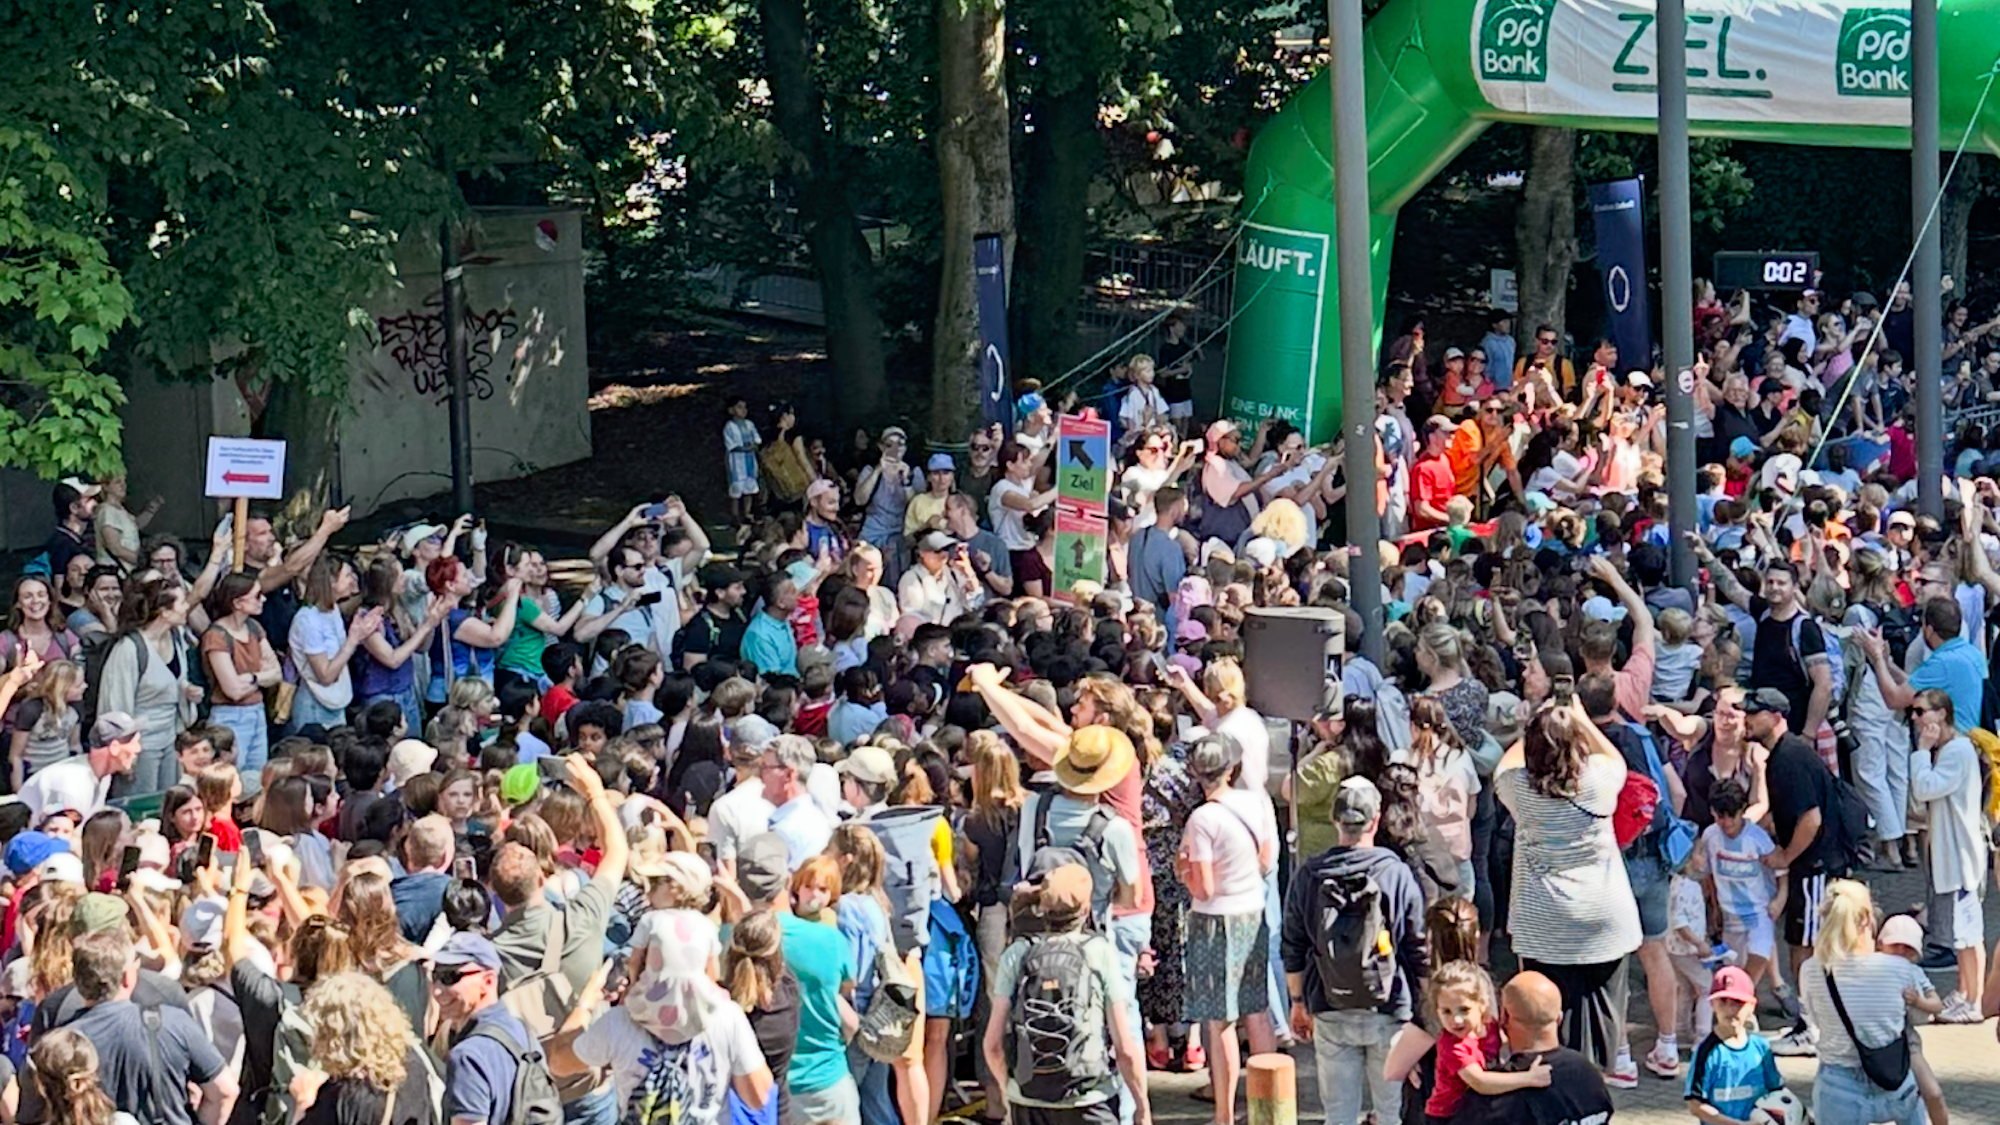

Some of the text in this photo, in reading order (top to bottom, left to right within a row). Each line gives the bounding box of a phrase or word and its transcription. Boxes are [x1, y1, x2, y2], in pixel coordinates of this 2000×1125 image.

[1612, 13, 1768, 81] ZEL.
[1484, 48, 1541, 75] Bank
[1841, 62, 1910, 91] Bank
[1070, 473, 1094, 491] Ziel
